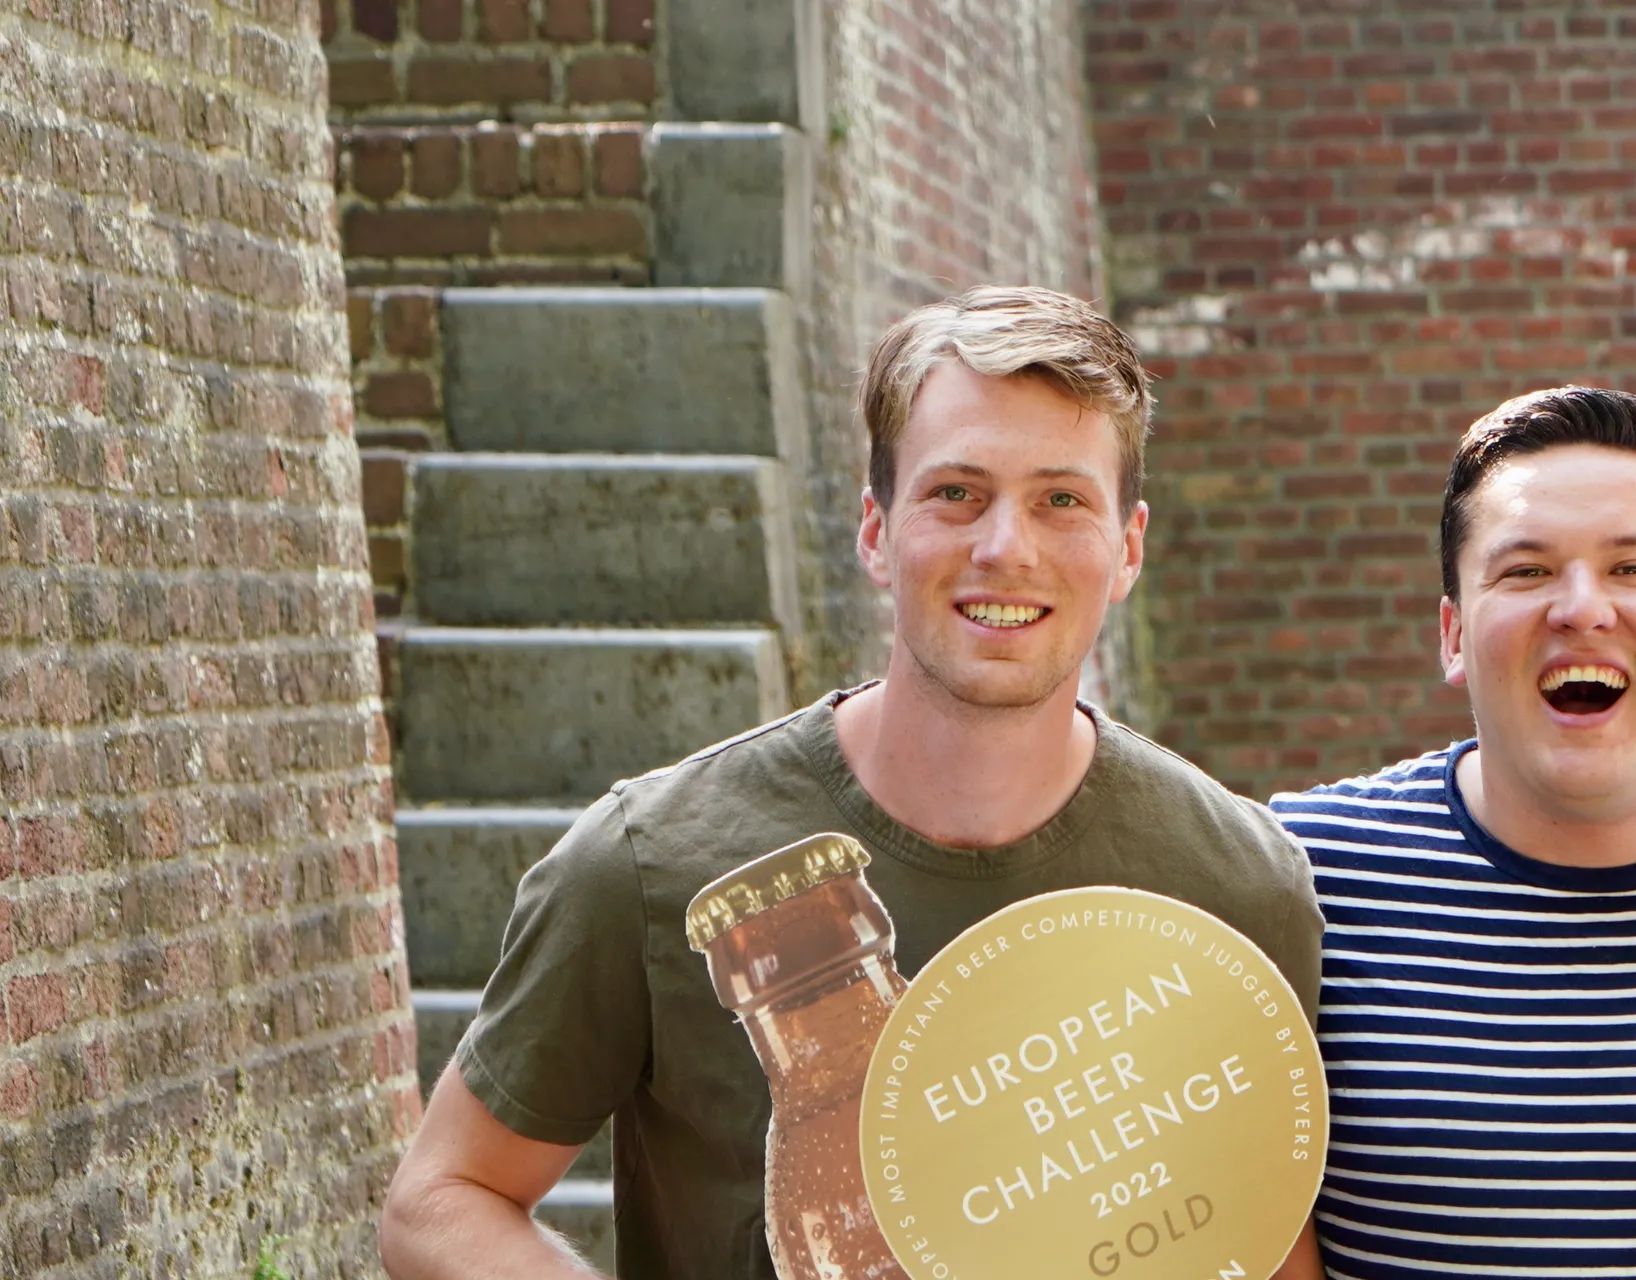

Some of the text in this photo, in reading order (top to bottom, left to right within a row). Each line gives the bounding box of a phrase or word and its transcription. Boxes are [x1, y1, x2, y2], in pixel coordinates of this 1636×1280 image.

[956, 936, 1011, 979] BEER
[1021, 910, 1197, 946] COMPETITION
[1203, 941, 1279, 1020] JUDGED
[881, 983, 953, 1120] IMPORTANT
[923, 962, 1193, 1123] EUROPEAN
[1275, 1027, 1298, 1056] BY
[1023, 1052, 1144, 1135] BEER
[1289, 1068, 1310, 1161] BUYERS
[880, 1134, 907, 1203] MOST
[962, 1054, 1252, 1224] CHALLENGE
[1090, 1162, 1172, 1218] 2022
[1088, 1194, 1214, 1278] GOLD
